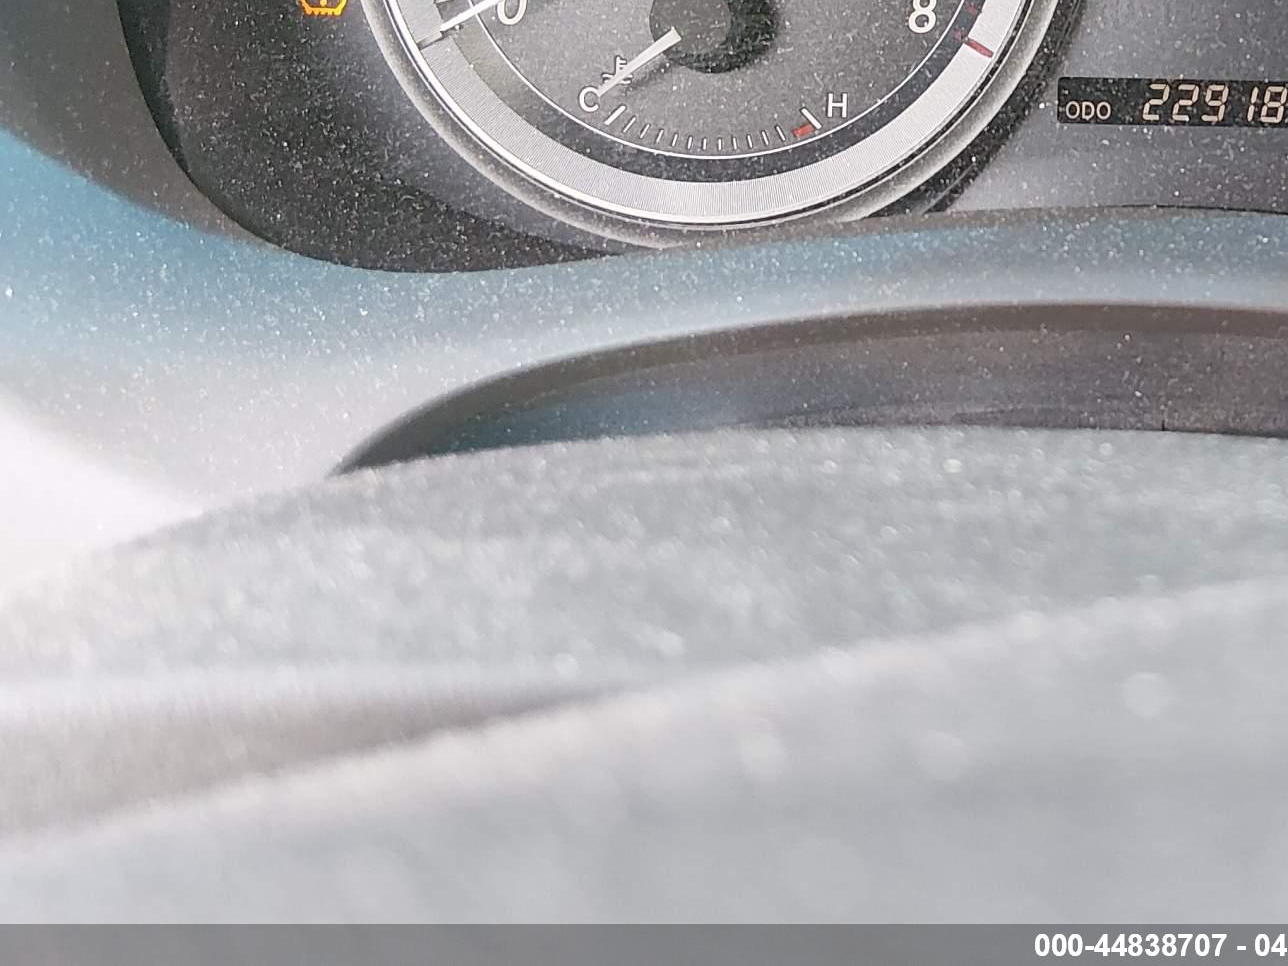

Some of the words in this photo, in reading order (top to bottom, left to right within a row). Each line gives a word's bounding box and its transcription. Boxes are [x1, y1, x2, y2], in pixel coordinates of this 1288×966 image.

[579, 86, 601, 113] C
[826, 93, 849, 118] H
[1065, 100, 1112, 121] ODO
